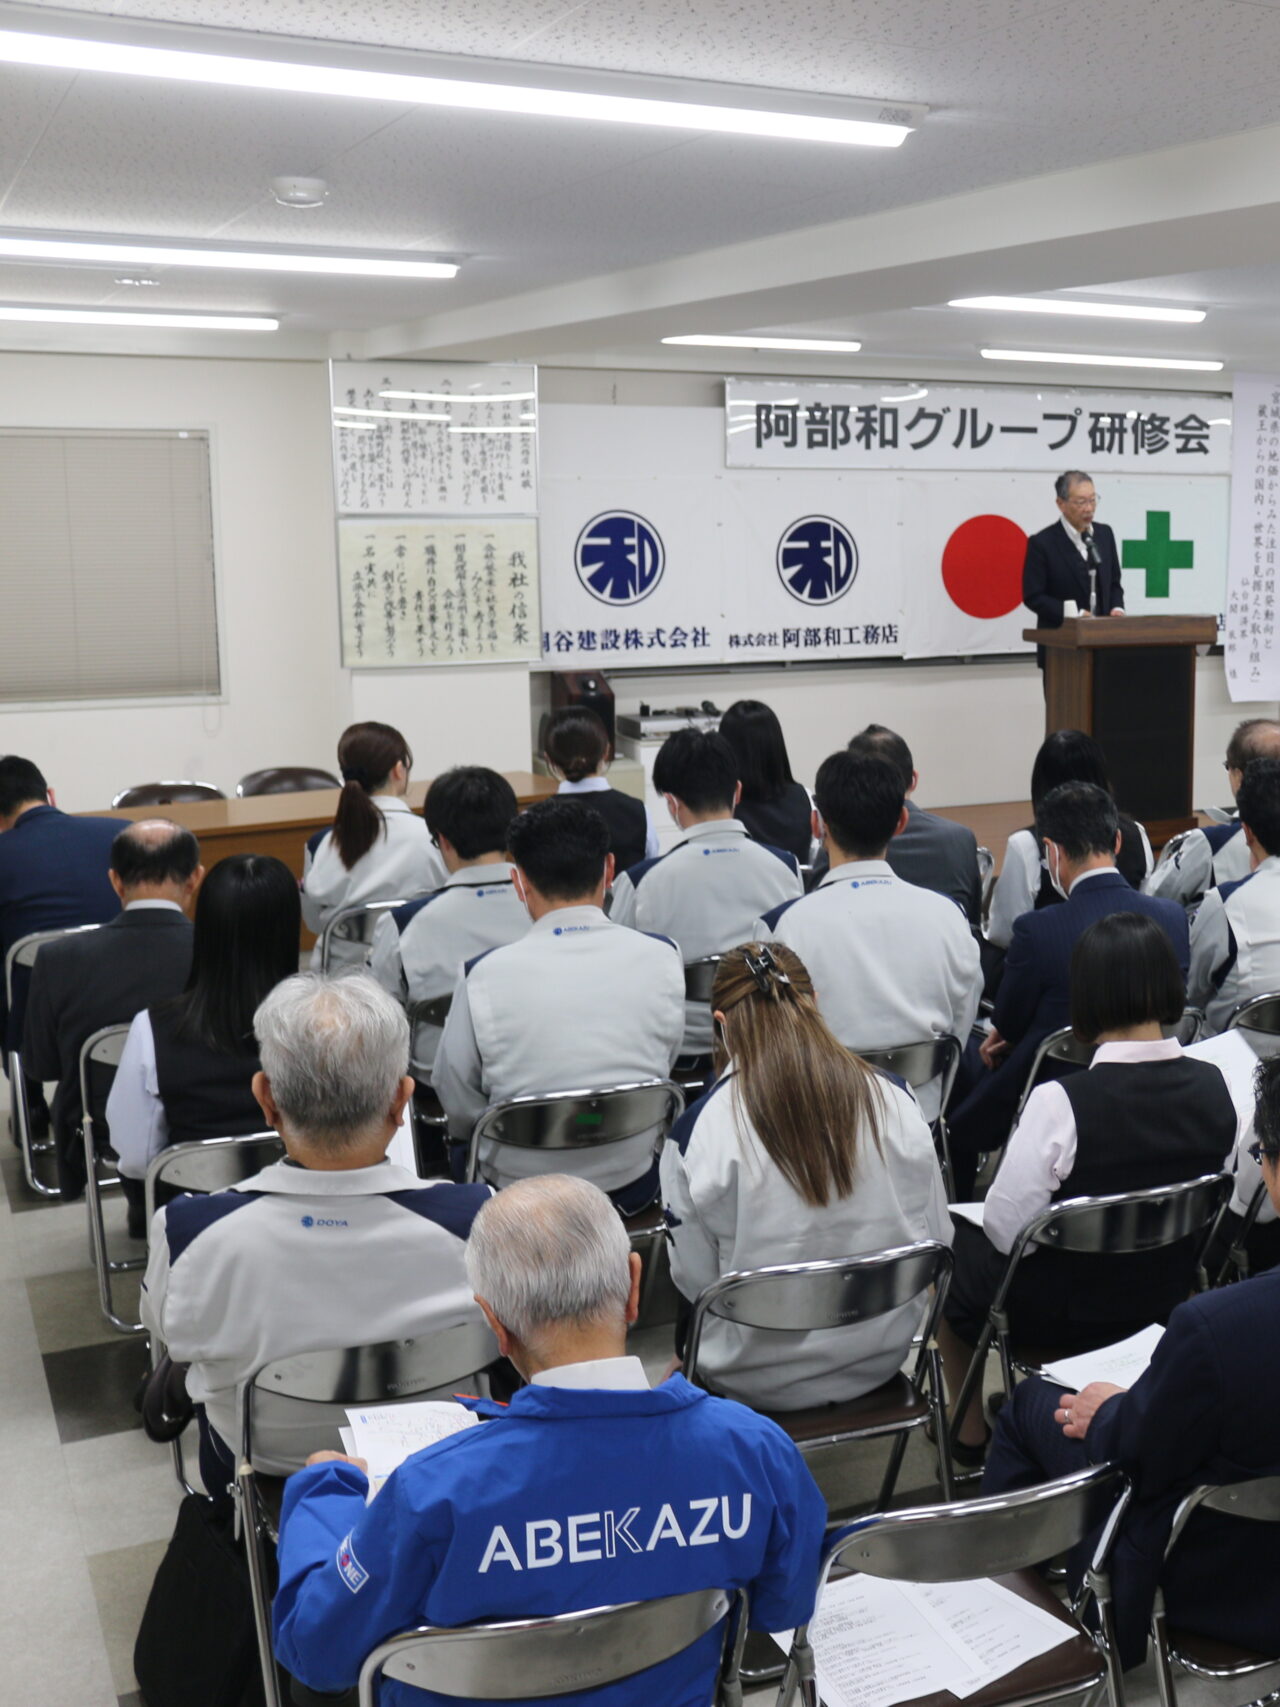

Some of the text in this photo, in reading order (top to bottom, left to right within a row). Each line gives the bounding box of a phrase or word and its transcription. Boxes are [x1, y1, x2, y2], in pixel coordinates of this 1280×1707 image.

[755, 403, 1211, 456] 阿部和グループ研修会
[508, 551, 529, 645] 我社の信条
[316, 1219, 348, 1227] DOYA
[478, 1494, 752, 1574] ABEKAZU
